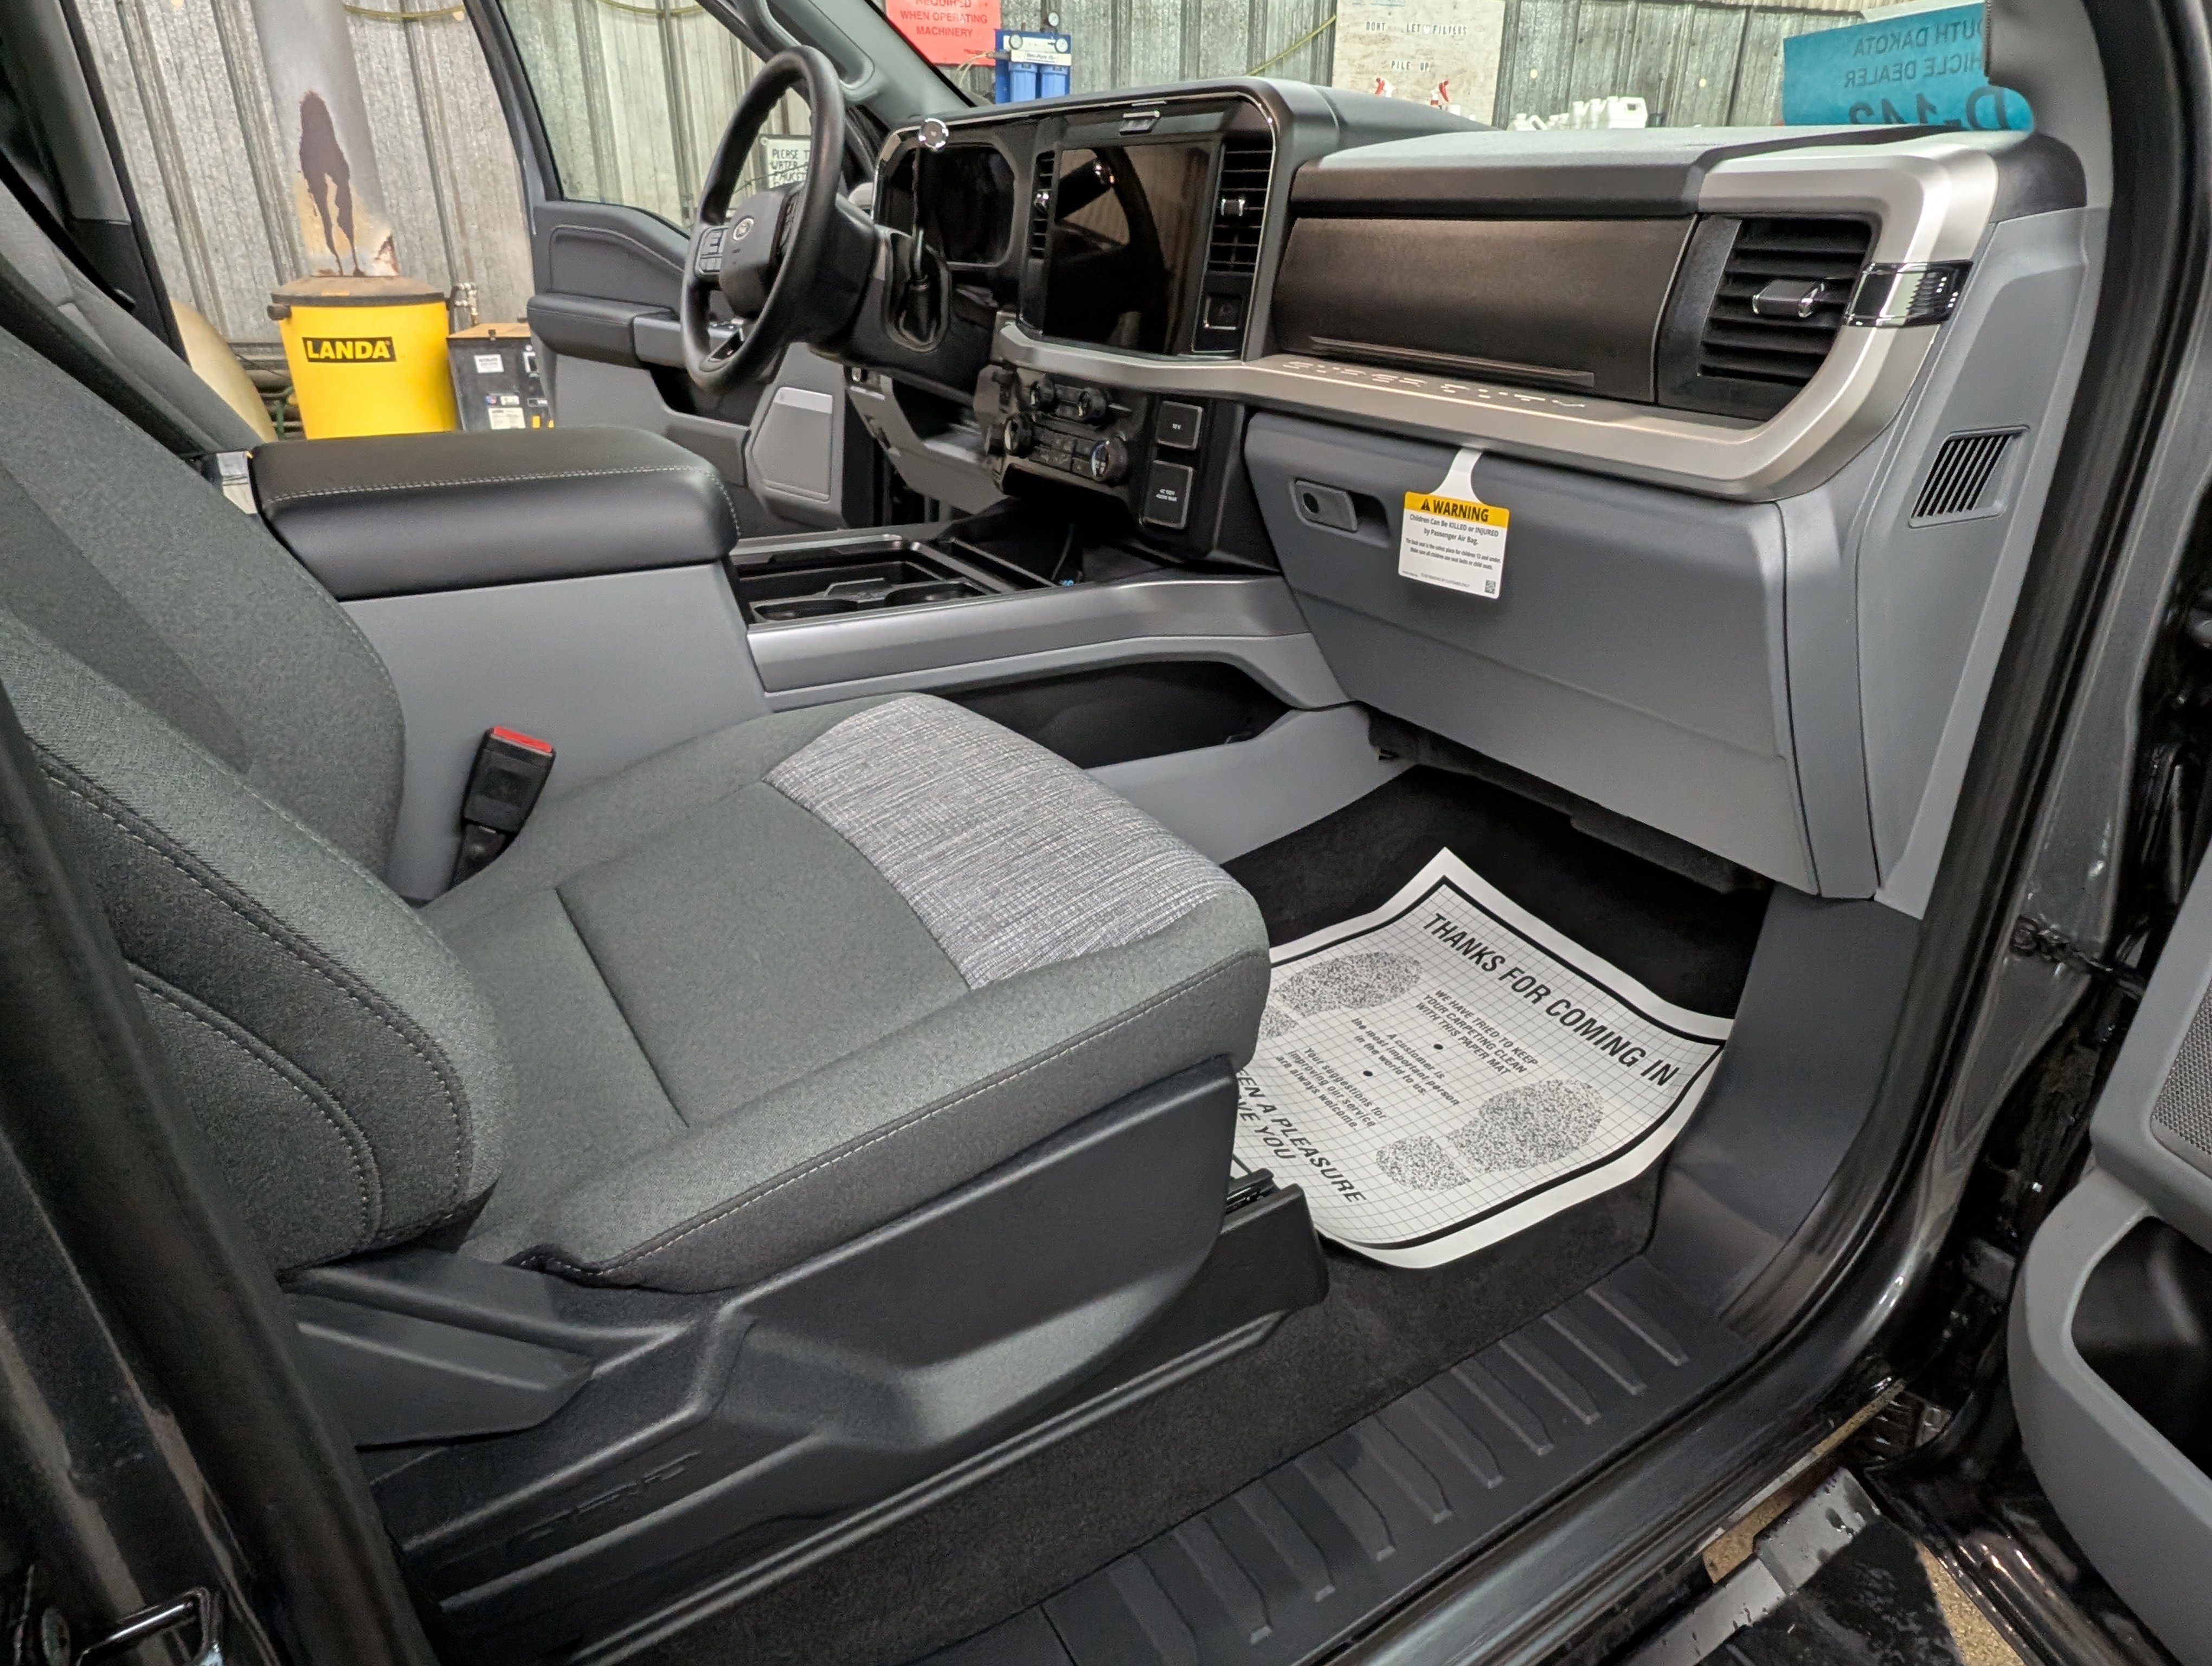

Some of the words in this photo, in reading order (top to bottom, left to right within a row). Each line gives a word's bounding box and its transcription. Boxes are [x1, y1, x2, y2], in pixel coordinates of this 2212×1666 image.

[900, 11, 929, 20] WHEN
[933, 12, 988, 23] OPERATING
[917, 26, 973, 37] MACHINERY
[1366, 22, 1385, 31] DONT
[1406, 24, 1420, 33] LET
[1433, 25, 1467, 35] FILTERS
[1391, 60, 1410, 70] PILE
[773, 149, 798, 159] PLEASE
[306, 341, 390, 359] LANDA
[1410, 514, 1430, 523] Children
[1449, 522, 1467, 531] KILLED
[1475, 526, 1499, 537] INJURED
[1433, 499, 1489, 522] WARNING
[1424, 528, 1430, 536] by
[1431, 529, 1456, 540] Passenger
[1422, 913, 1506, 973] THANKS
[1498, 967, 1551, 1004] FOR
[1546, 999, 1647, 1068] COMING
[1640, 1059, 1680, 1087] IN
[1416, 1003, 1441, 1021] WITH
[1438, 1020, 1461, 1037] THIS
[1457, 1036, 1490, 1060] PAPER
[1487, 1059, 1511, 1075] MAT
[1423, 995, 1449, 1014] YOUR
[1446, 1013, 1496, 1050] CARPETING
[1494, 1049, 1527, 1073] CLEAN
[1435, 990, 1452, 1002] WE
[1449, 1000, 1474, 1019] HAVE
[1472, 1017, 1500, 1038] TRIED
[1499, 1037, 1514, 1048] TO
[1512, 1047, 1539, 1066] KEEP
[1276, 1056, 1292, 1068] are
[1290, 1068, 1320, 1094] always
[1352, 1018, 1367, 1030] the
[1366, 1030, 1388, 1047] most
[1386, 1046, 1430, 1080] important
[1425, 1080, 1460, 1106] person
[1354, 1035, 1365, 1043] in
[1364, 1042, 1379, 1055] the
[1379, 1055, 1405, 1075] world
[1403, 1074, 1414, 1084] to
[1413, 1083, 1426, 1096] us.
[1394, 1040, 1435, 1071] customer
[1433, 1071, 1445, 1079] is
[1288, 1050, 1329, 1086] improving
[1327, 1086, 1345, 1099] our
[1342, 1098, 1376, 1127] service
[1304, 1047, 1325, 1065] Your
[1322, 1065, 1372, 1107] suggestions
[1371, 1106, 1387, 1119] for
[1254, 1125, 1296, 1159] YOU
[1256, 1103, 1277, 1114] A
[1271, 1117, 1367, 1202] PLEASURE
